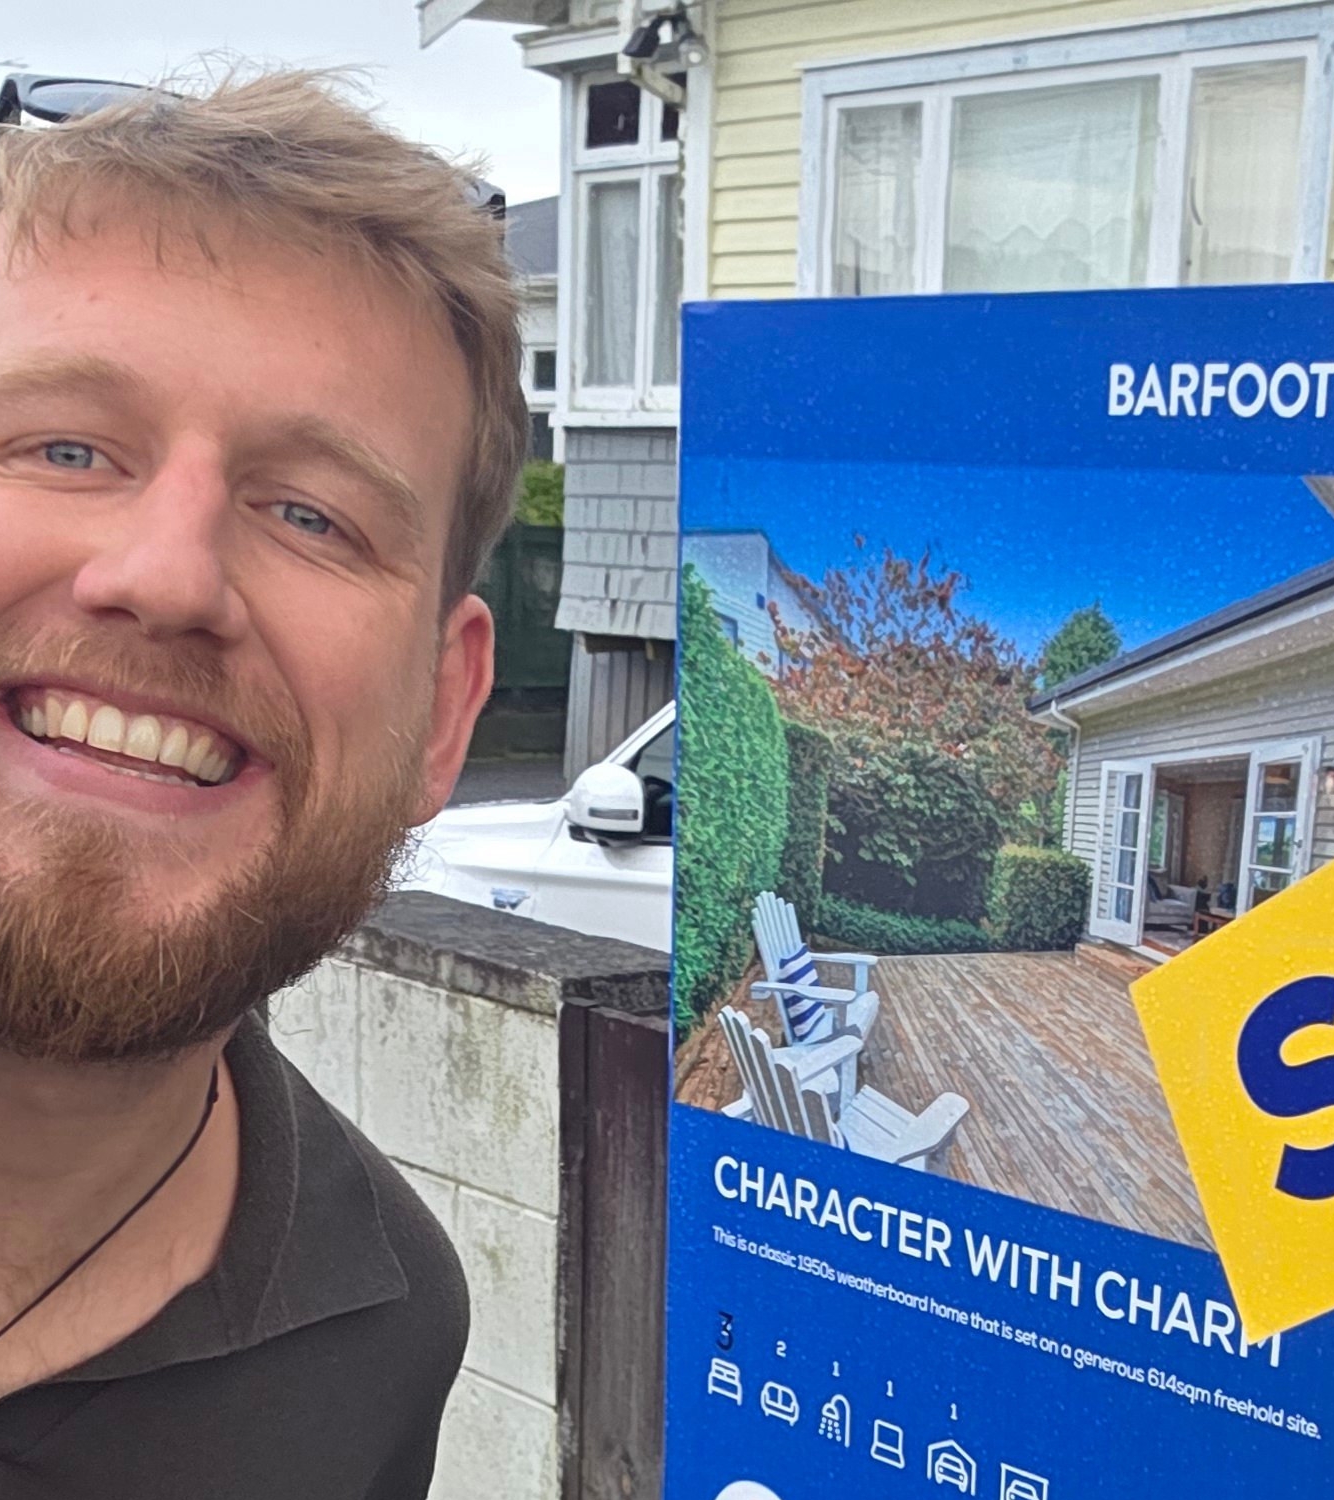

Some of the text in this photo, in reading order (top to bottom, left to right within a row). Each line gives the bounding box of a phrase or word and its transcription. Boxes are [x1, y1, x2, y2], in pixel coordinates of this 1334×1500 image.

[713, 1155, 952, 1267] CHARACTER
[964, 1229, 1081, 1307] WITH
[712, 1225, 1321, 1440] This is a classic 1950s weatherboard home that is set on a generous 614sqm freehold site.
[716, 1310, 958, 1420] 3 2 1 1 1
